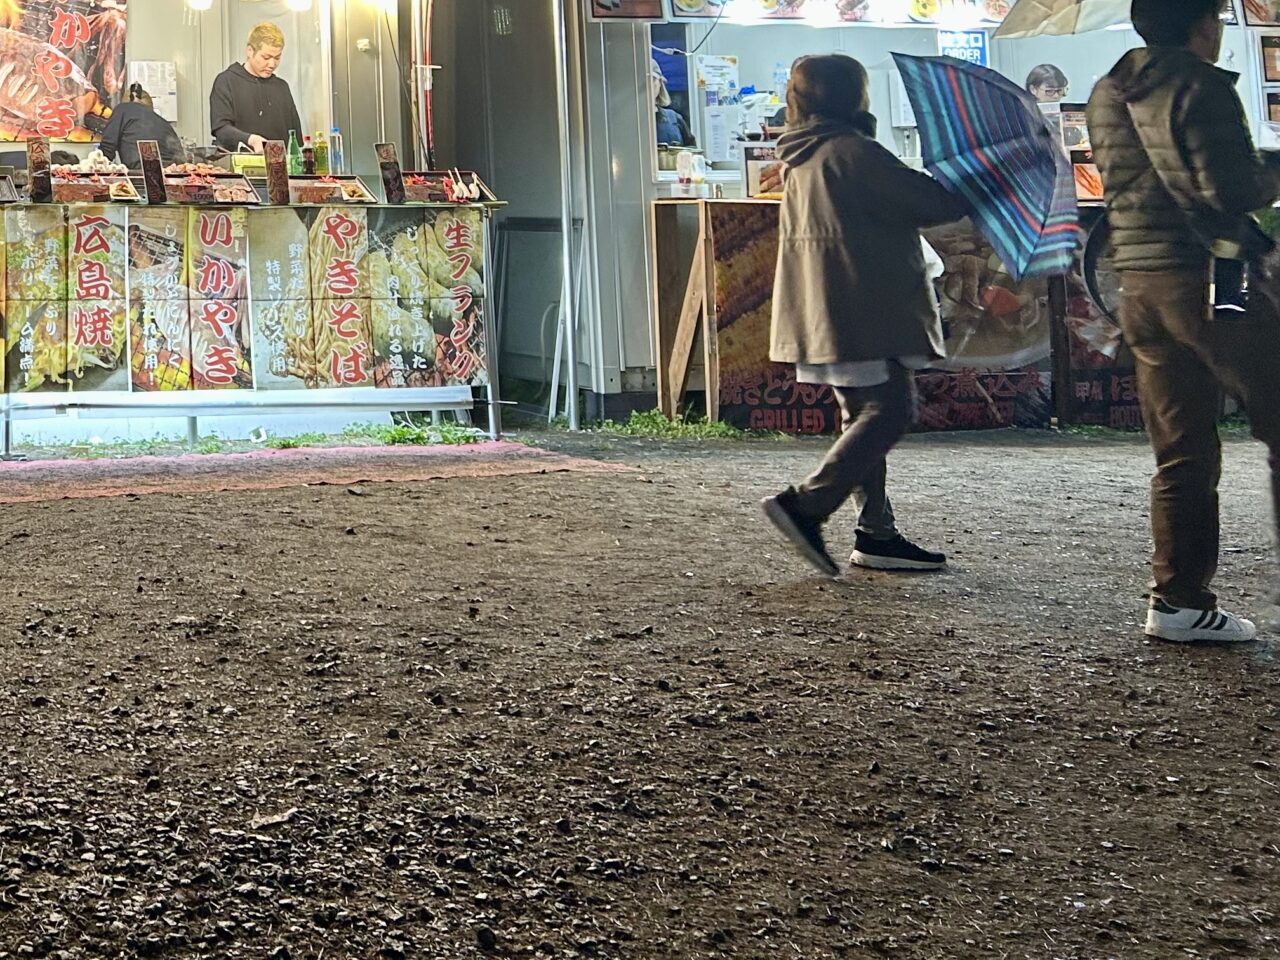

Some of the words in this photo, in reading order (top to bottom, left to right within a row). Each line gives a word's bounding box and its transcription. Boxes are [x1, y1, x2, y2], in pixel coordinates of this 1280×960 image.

[73, 213, 113, 347] 広島焼
[199, 213, 239, 385] いかやき
[288, 243, 306, 338] 野菜たっぷり
[323, 213, 368, 385] やきそば
[406, 226, 428, 369] じっくり焼き上げた
[444, 219, 475, 380] 生フランク
